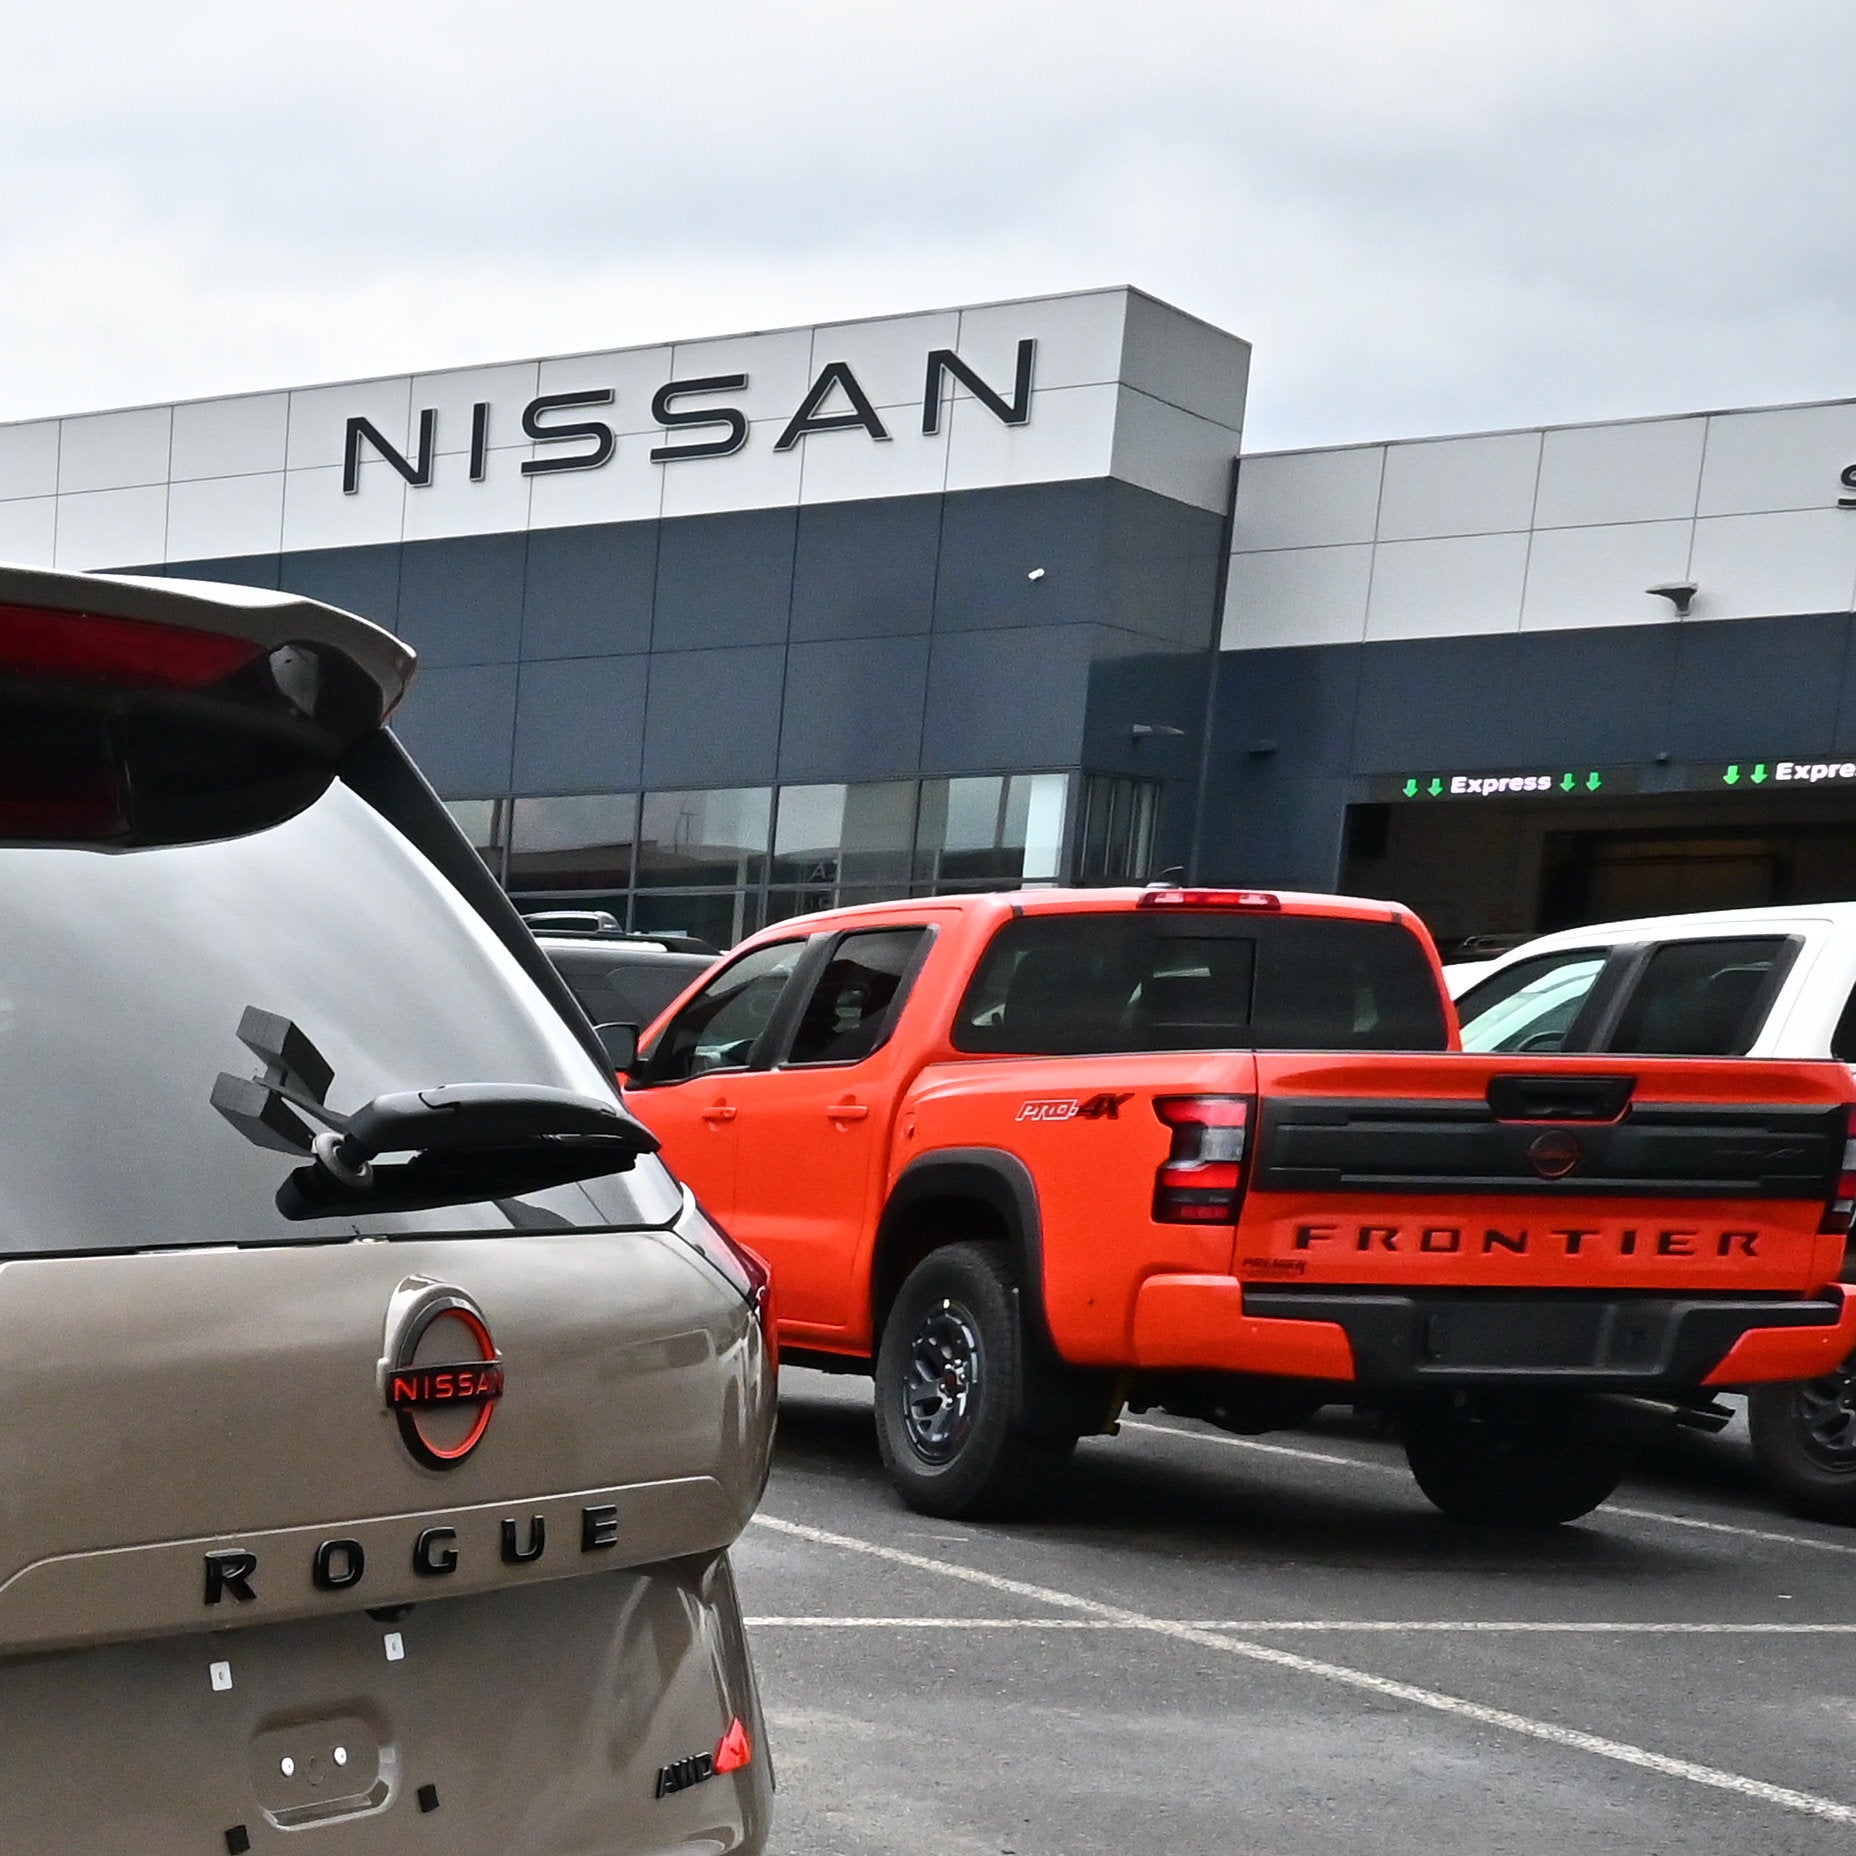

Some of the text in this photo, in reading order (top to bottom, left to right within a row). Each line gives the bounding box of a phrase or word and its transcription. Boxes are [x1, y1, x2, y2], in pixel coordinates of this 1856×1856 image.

[342, 338, 1038, 495] NISSAN
[1450, 774, 1553, 796] Express
[1775, 762, 1856, 783] Expre
[1293, 1223, 1761, 1258] FRONTIER
[204, 1504, 618, 1606] ROGUE
[655, 1750, 714, 1800] AWD
